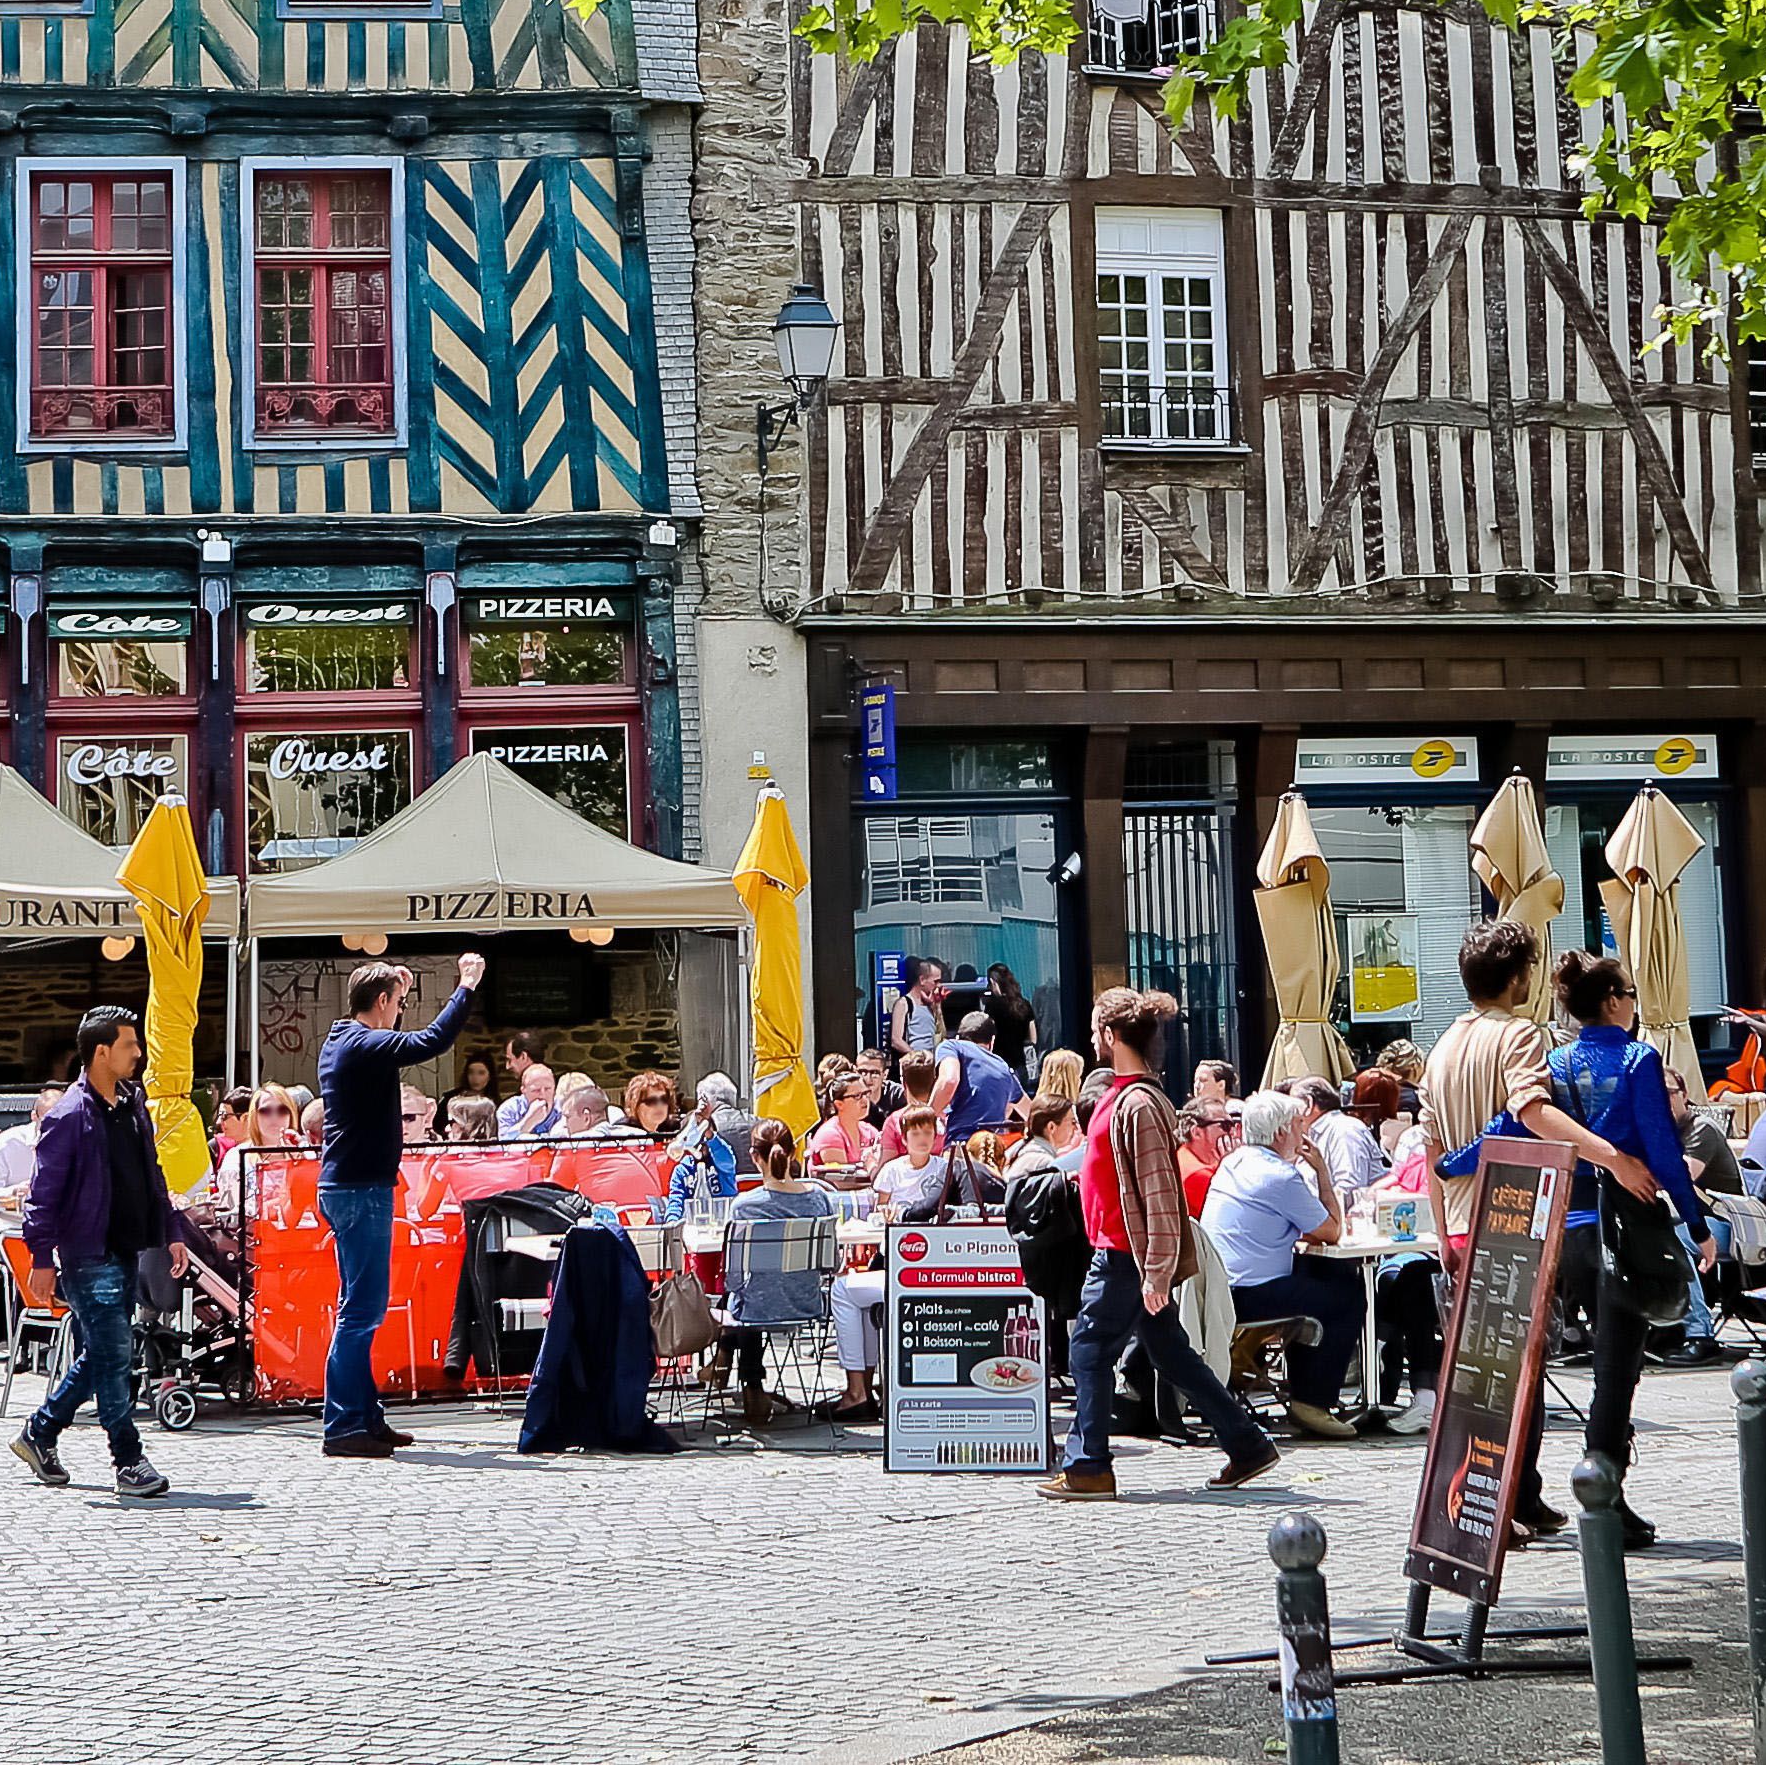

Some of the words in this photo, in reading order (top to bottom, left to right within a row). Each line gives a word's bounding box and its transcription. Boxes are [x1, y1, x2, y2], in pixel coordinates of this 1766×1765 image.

[247, 603, 408, 623] Ouest
[478, 597, 616, 619] PIZZERIA
[57, 613, 182, 633] Côte
[269, 738, 389, 781] Ouest
[490, 743, 609, 763] PIZZERIA
[1311, 755, 1333, 766] LA
[1344, 754, 1403, 765] POSTE
[1560, 752, 1581, 763] LA
[1591, 751, 1646, 763] POSTE
[66, 744, 178, 785] Côte
[406, 891, 599, 922] PIZZERIA
[945, 1241, 962, 1254] Le
[918, 1271, 928, 1283] la
[931, 1271, 975, 1283] formule
[977, 1271, 1016, 1283] bistrot
[903, 1302, 911, 1315] 7
[914, 1302, 943, 1317] plats
[923, 1320, 962, 1332] dessert
[973, 1319, 1000, 1332] café
[923, 1336, 963, 1348] Boisson
[920, 1400, 941, 1408] carte
